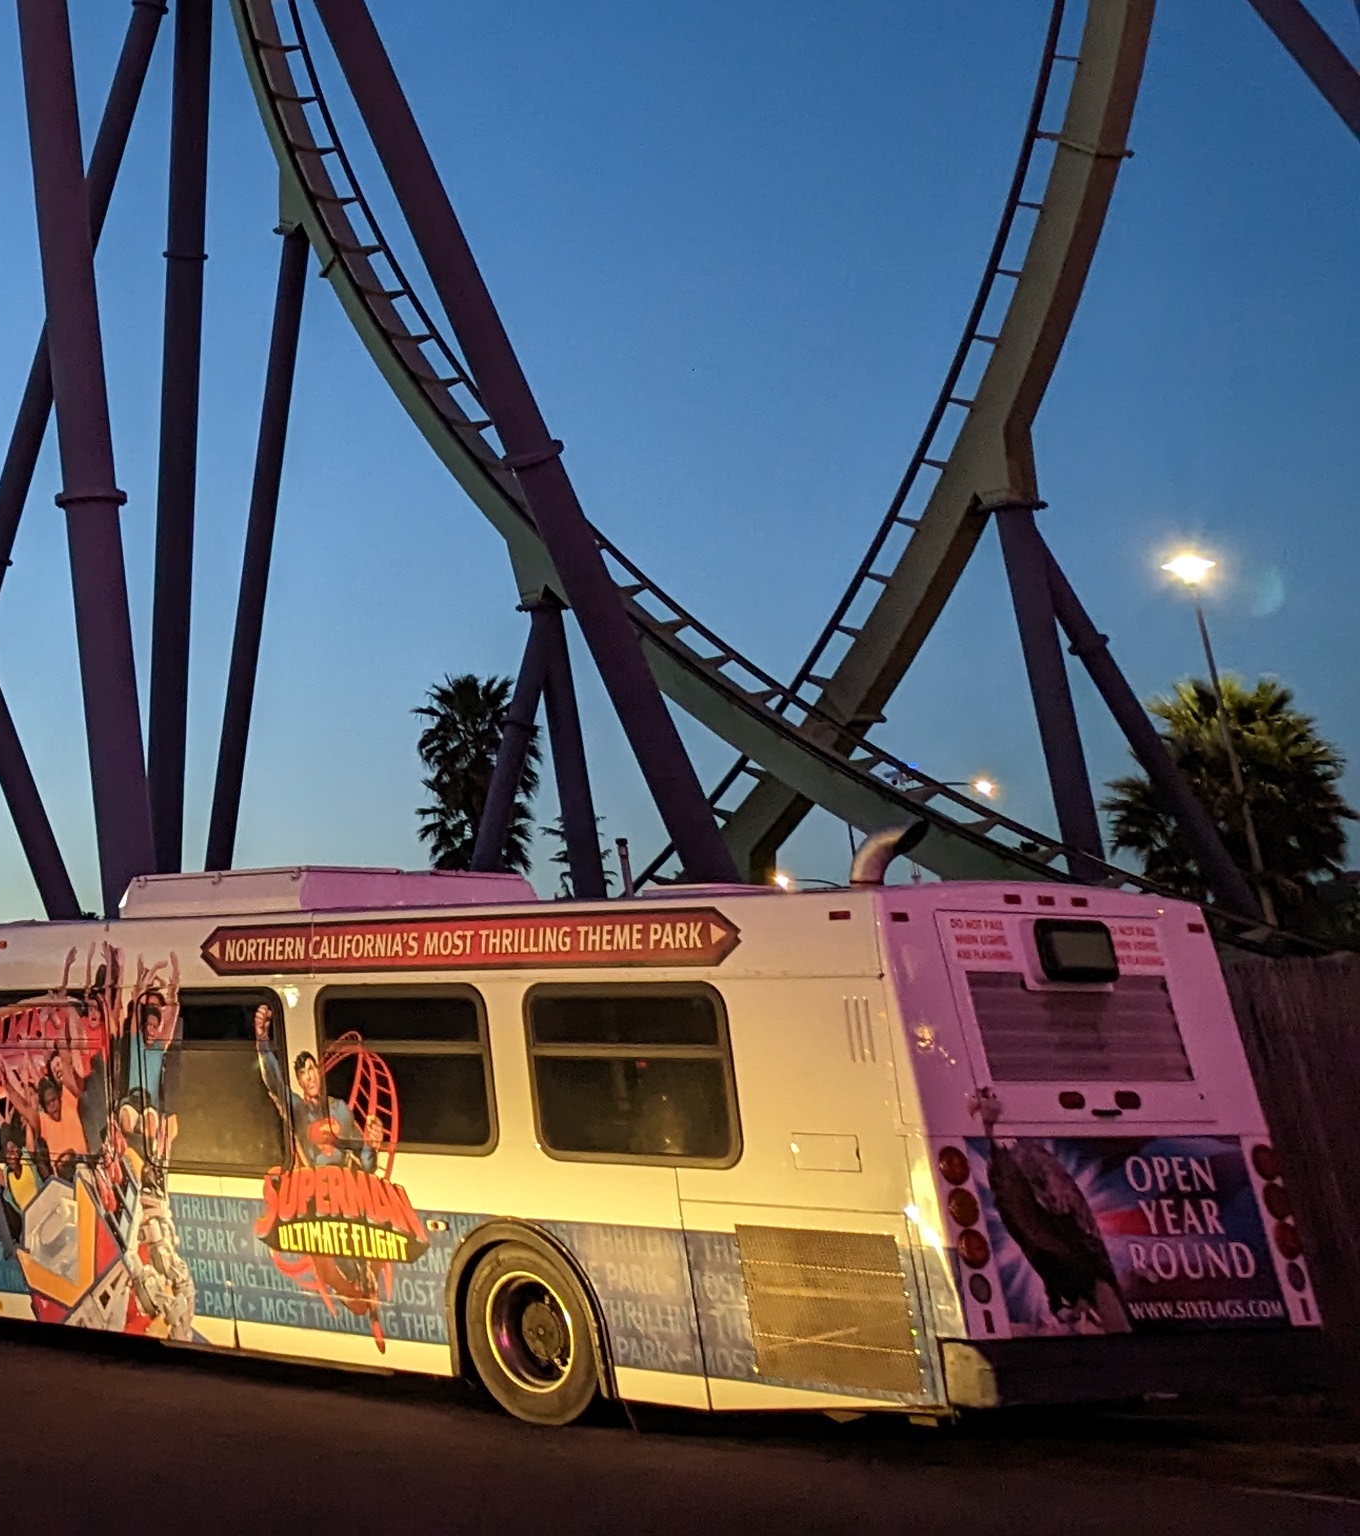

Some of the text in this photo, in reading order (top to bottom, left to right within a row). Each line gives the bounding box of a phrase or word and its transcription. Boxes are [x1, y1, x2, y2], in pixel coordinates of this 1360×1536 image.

[225, 922, 704, 962] NORTHERN CALIFORNIA'S MOST THRILLING THEME PARK
[1125, 1156, 1217, 1192] OPEN
[171, 1195, 250, 1225] THRILLING
[254, 1165, 429, 1243] SUPERMAN
[1138, 1199, 1226, 1235] YEAR
[197, 1228, 239, 1255] PARK
[278, 1220, 352, 1257] ULTIMATE
[352, 1225, 408, 1262] FLIGHT
[186, 1257, 257, 1288] HRILLING
[1129, 1242, 1257, 1280] ROUND
[204, 1290, 245, 1319] PARK
[260, 1296, 308, 1326] MOST
[1128, 1300, 1283, 1320] WWW.SIXFLAGS.COM
